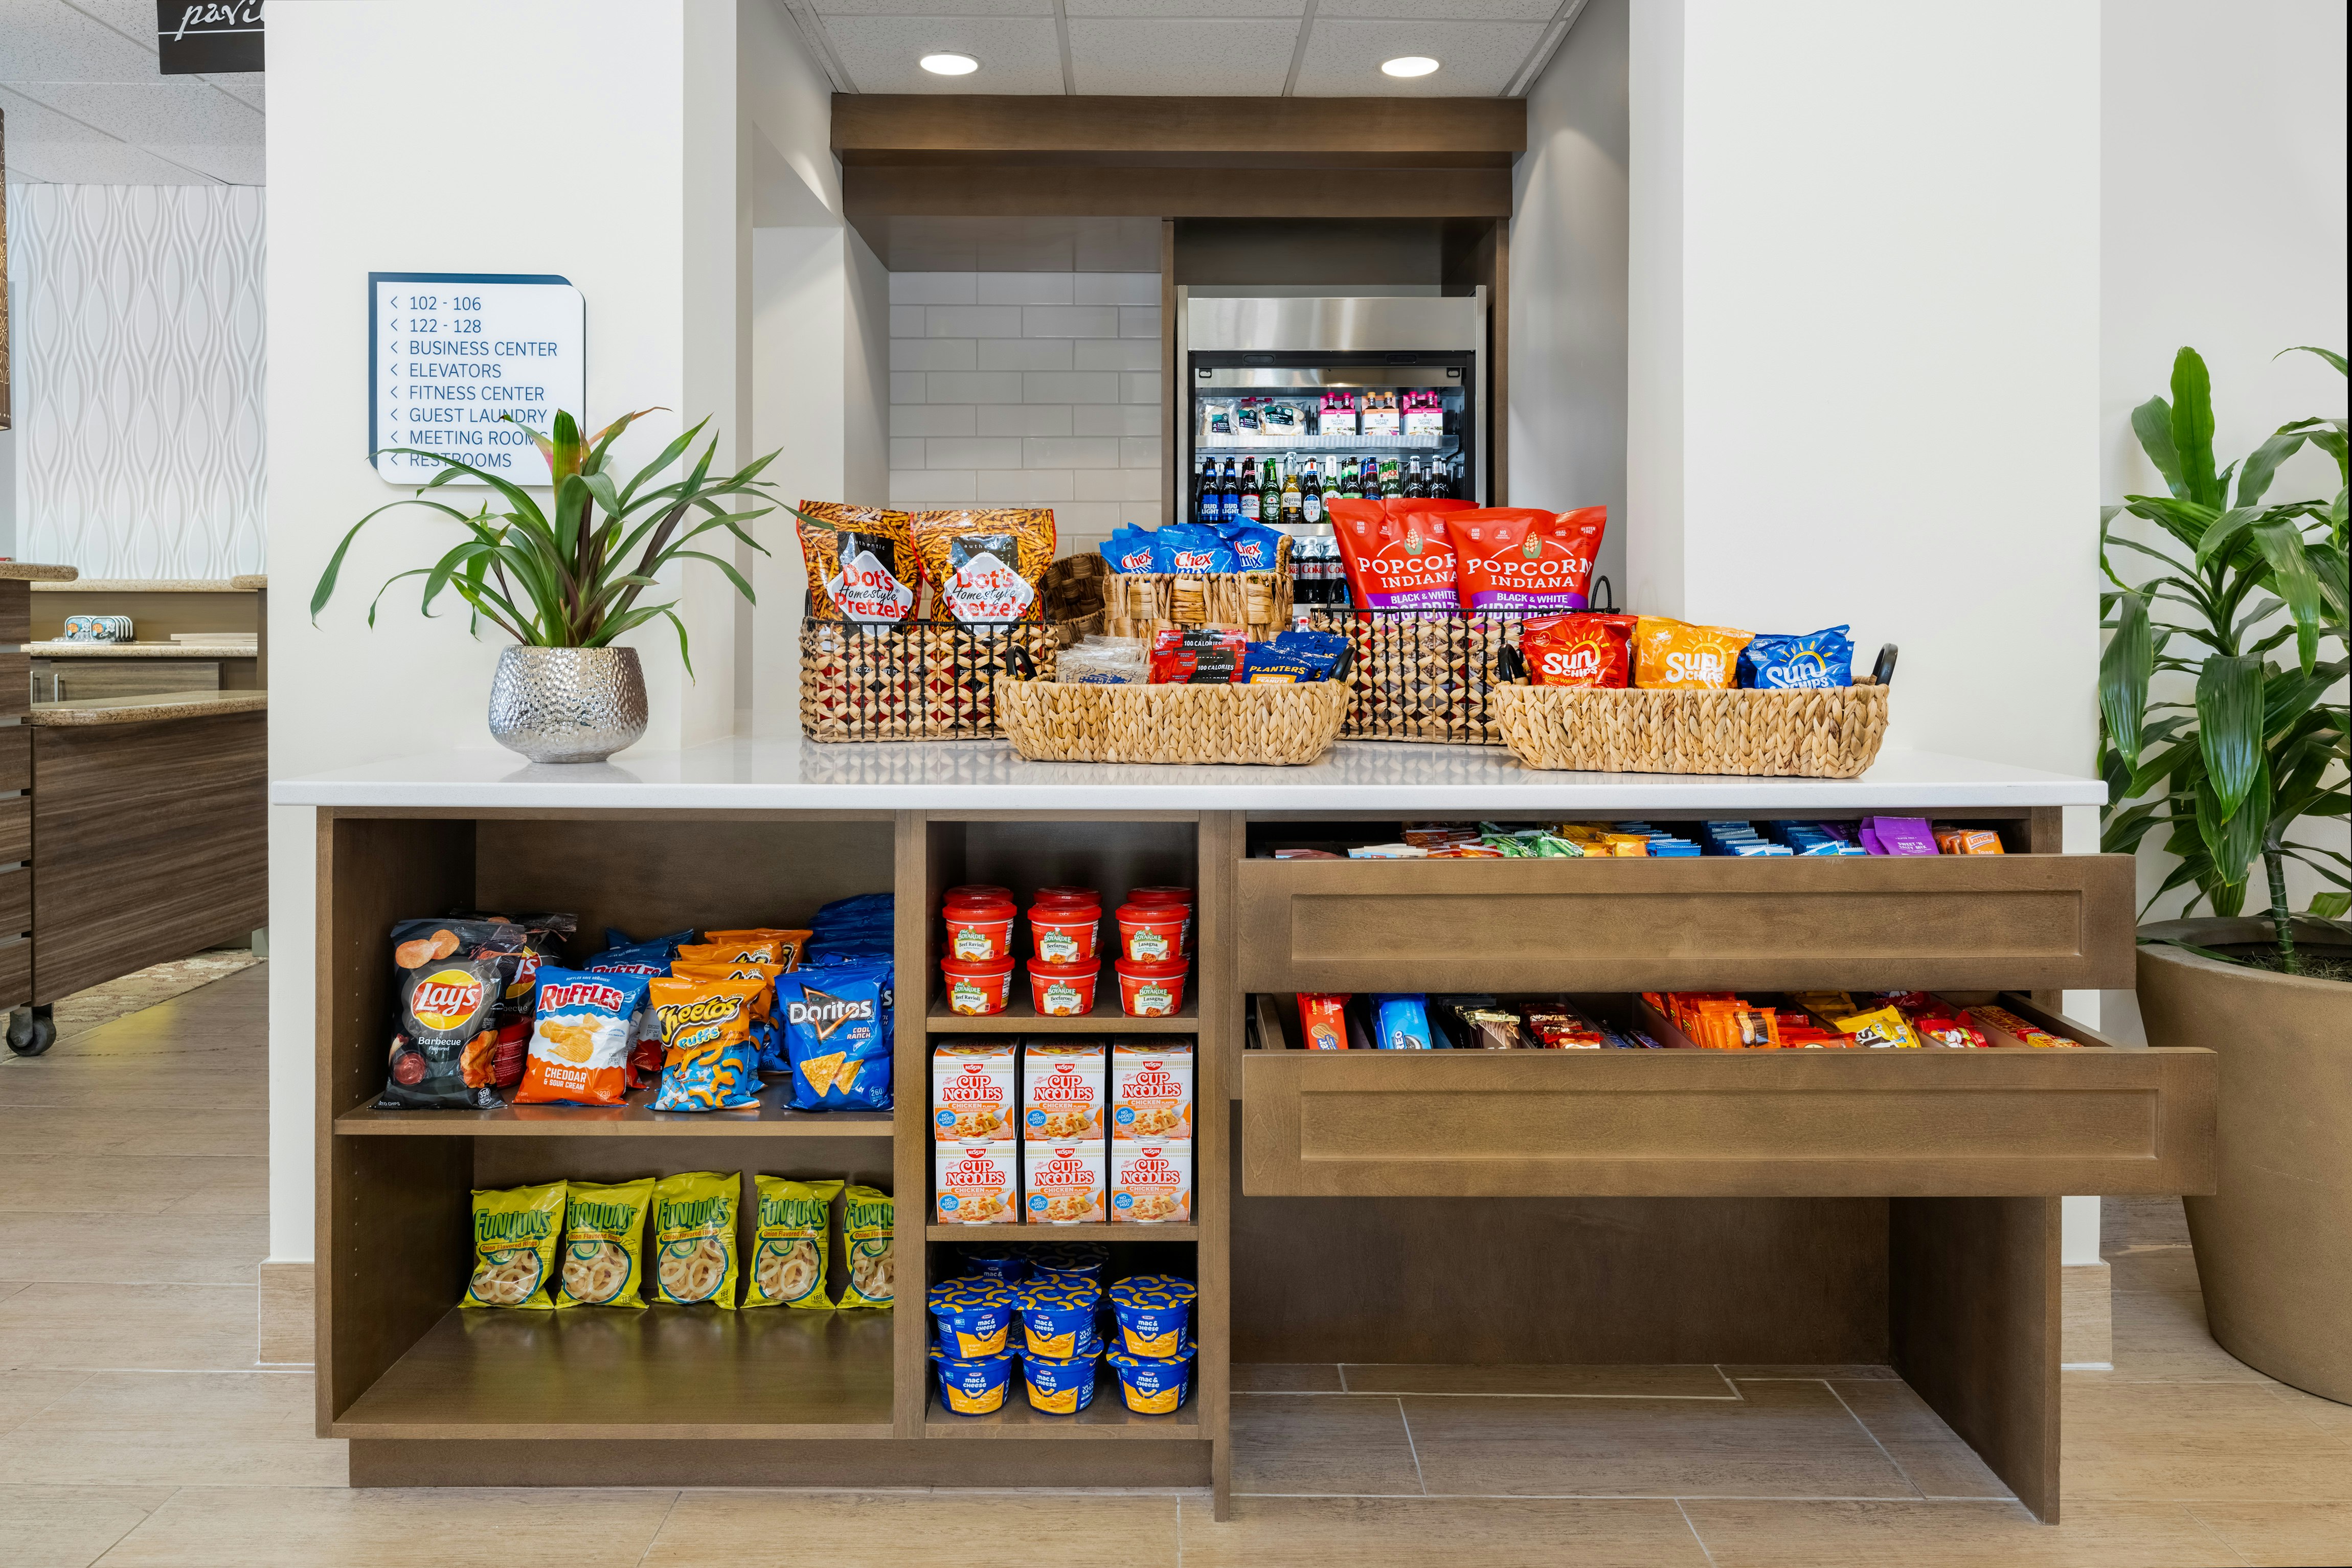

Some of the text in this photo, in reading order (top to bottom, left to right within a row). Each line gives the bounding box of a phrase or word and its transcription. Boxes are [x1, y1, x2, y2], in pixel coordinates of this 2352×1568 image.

[410, 297, 437, 310] 102
[454, 297, 481, 310] 106
[410, 319, 437, 332] 122
[454, 320, 481, 333] 128
[410, 340, 557, 356] BUSINESS CENTER
[410, 363, 501, 377] ELEVATORS
[410, 385, 544, 401] FITNESS CENTER
[410, 408, 547, 423] GUEST LAUNDRY
[410, 430, 482, 445] MEETING
[410, 453, 511, 467] RESTROOMS
[1234, 541, 1261, 554] Chex
[1122, 548, 1152, 569] Chex
[1175, 552, 1213, 566] Chex
[1240, 554, 1261, 568] mix
[1358, 553, 1457, 574] POPCOR
[1302, 564, 1322, 573] Coke
[1466, 558, 1593, 577] POPCORN
[843, 564, 894, 592] Dot's
[957, 567, 1014, 588] Dot's
[1381, 572, 1458, 588] INDIANA
[1490, 575, 1574, 588] INDIANA
[839, 582, 898, 605] Homestyle
[1391, 593, 1420, 604] BLACK
[1428, 591, 1457, 600] WHITE
[1497, 593, 1527, 601] BLACK
[1537, 595, 1568, 603] WHITE
[834, 593, 908, 619] Pretzels
[946, 596, 1027, 617] Pretzels
[1542, 650, 1600, 674] Sun
[1249, 666, 1306, 674] PLANTERS
[1563, 666, 1598, 677] CHIPS
[1766, 663, 1826, 689] Sun
[1968, 833, 1992, 846] Lance
[416, 983, 480, 1017] Lay's
[537, 983, 624, 1012] RUFFLES
[790, 1001, 872, 1024] Doritos
[418, 1037, 461, 1046] Barbecue
[676, 1026, 720, 1050] Puffs
[545, 1067, 586, 1083] CHEDDAR
[957, 1076, 991, 1088] CUP
[1048, 1075, 1082, 1088] CUP
[1136, 1072, 1170, 1085] CUP
[550, 1079, 564, 1087] SOUR
[565, 1081, 584, 1090] CREAM
[1122, 1082, 1182, 1098] NOODLES
[479, 1089, 489, 1098] 350
[943, 1087, 1003, 1101] NOODLES
[1034, 1087, 1094, 1101] NOODLES
[959, 1160, 993, 1173] CUP
[1049, 1160, 1082, 1173] CUP
[1135, 1159, 1168, 1172] CUP
[946, 1171, 1005, 1186] NOODLES
[1035, 1171, 1094, 1186] NOODLES
[1121, 1171, 1180, 1185] NOODLES
[679, 1231, 701, 1239] Flavored
[497, 1242, 522, 1251] Flavored
